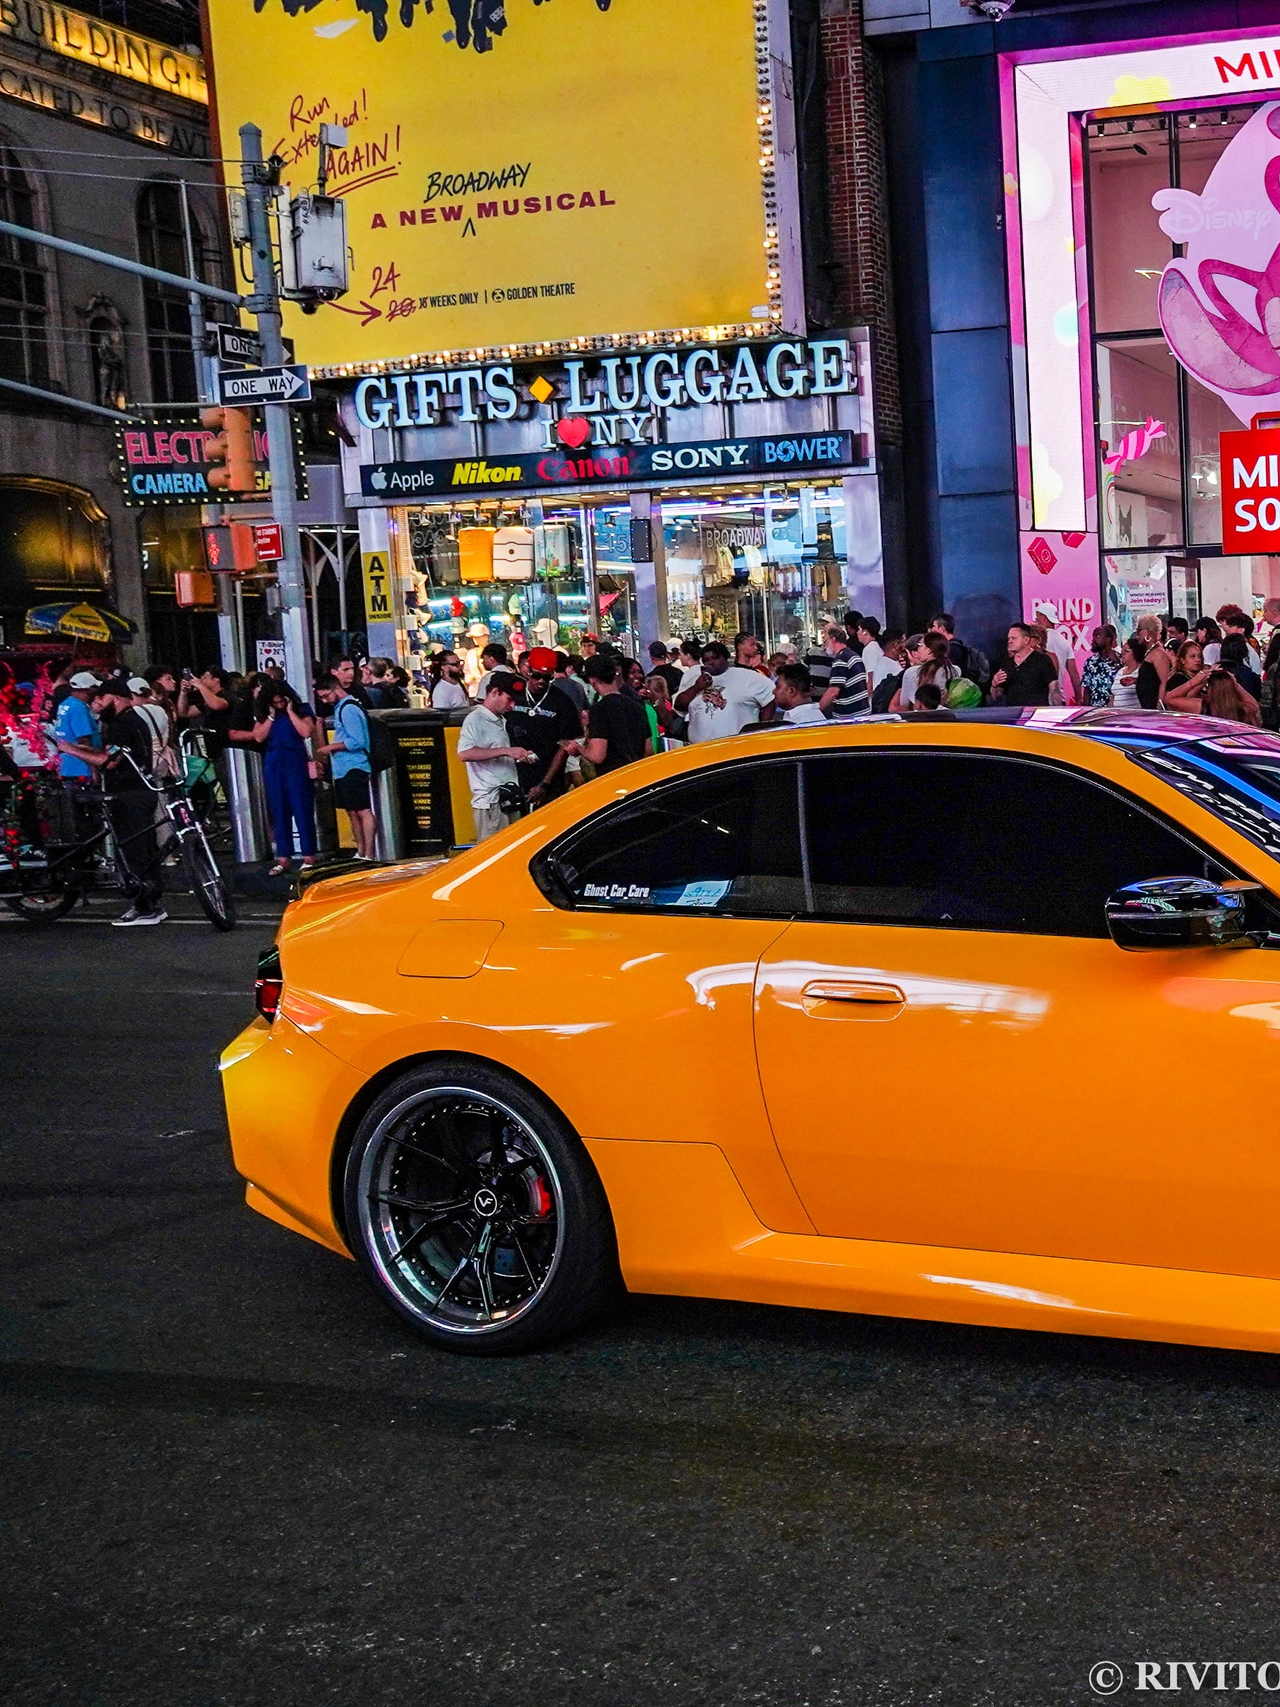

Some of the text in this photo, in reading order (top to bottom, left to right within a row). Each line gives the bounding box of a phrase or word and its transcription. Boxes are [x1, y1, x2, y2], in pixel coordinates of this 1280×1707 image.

[95, 99, 130, 131] TO
[290, 95, 330, 132] Run
[325, 124, 401, 179] AGAIN!
[424, 163, 531, 203] BROADWAY
[370, 190, 616, 229] A NEW MUSICAL
[370, 262, 400, 298] 24
[430, 295, 457, 308] WEEKS
[459, 292, 478, 306] ONLY
[507, 286, 539, 300] GOLDEN
[540, 283, 576, 297] THEATRE
[232, 377, 294, 395] ONE WAY
[355, 340, 850, 429] GIFTS LUGGAGE
[591, 412, 652, 446] NY
[652, 445, 748, 471] SONY
[765, 438, 840, 463] BOWER
[391, 470, 434, 491] Apple
[452, 462, 522, 486] Nikon
[537, 454, 631, 481] Canon
[131, 472, 208, 494] CAMERA
[706, 527, 766, 548] BROADWAY
[369, 556, 388, 612] ATM
